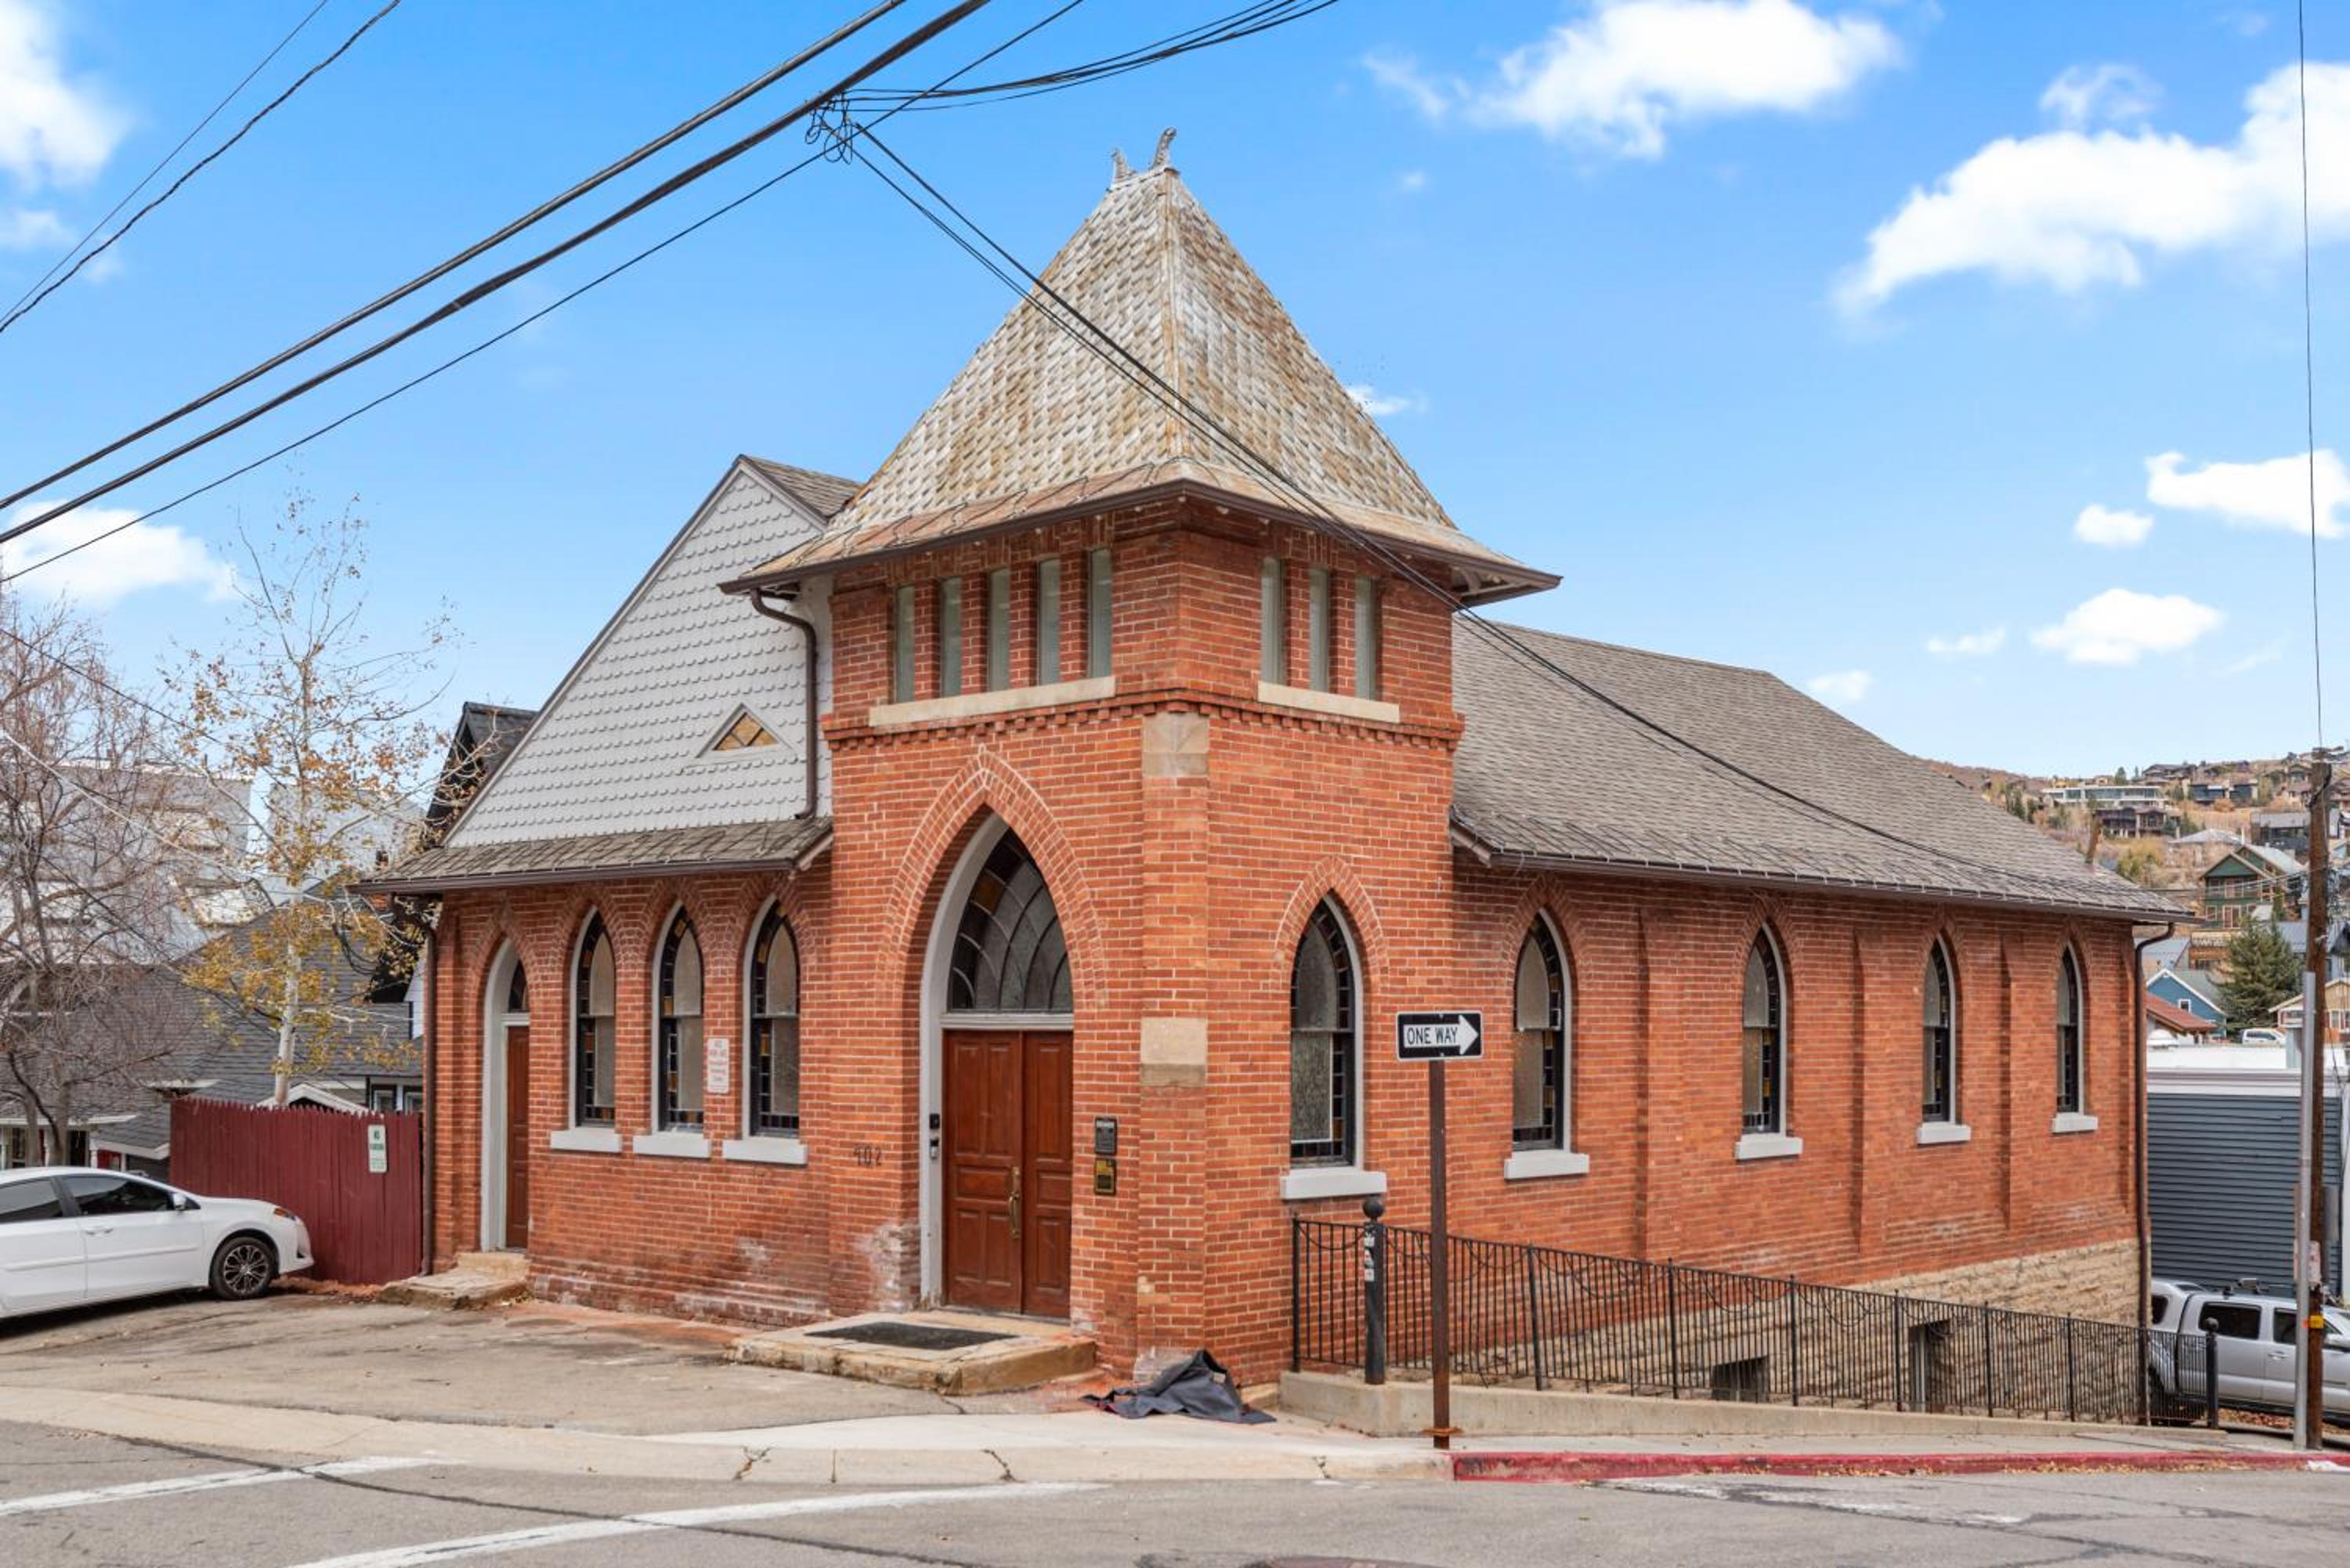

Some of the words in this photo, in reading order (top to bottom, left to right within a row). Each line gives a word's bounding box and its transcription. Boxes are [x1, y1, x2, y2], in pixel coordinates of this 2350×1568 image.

[1407, 1027, 1432, 1046] ONE
[1435, 1027, 1458, 1044] WAY
[853, 1146, 882, 1167] 402
